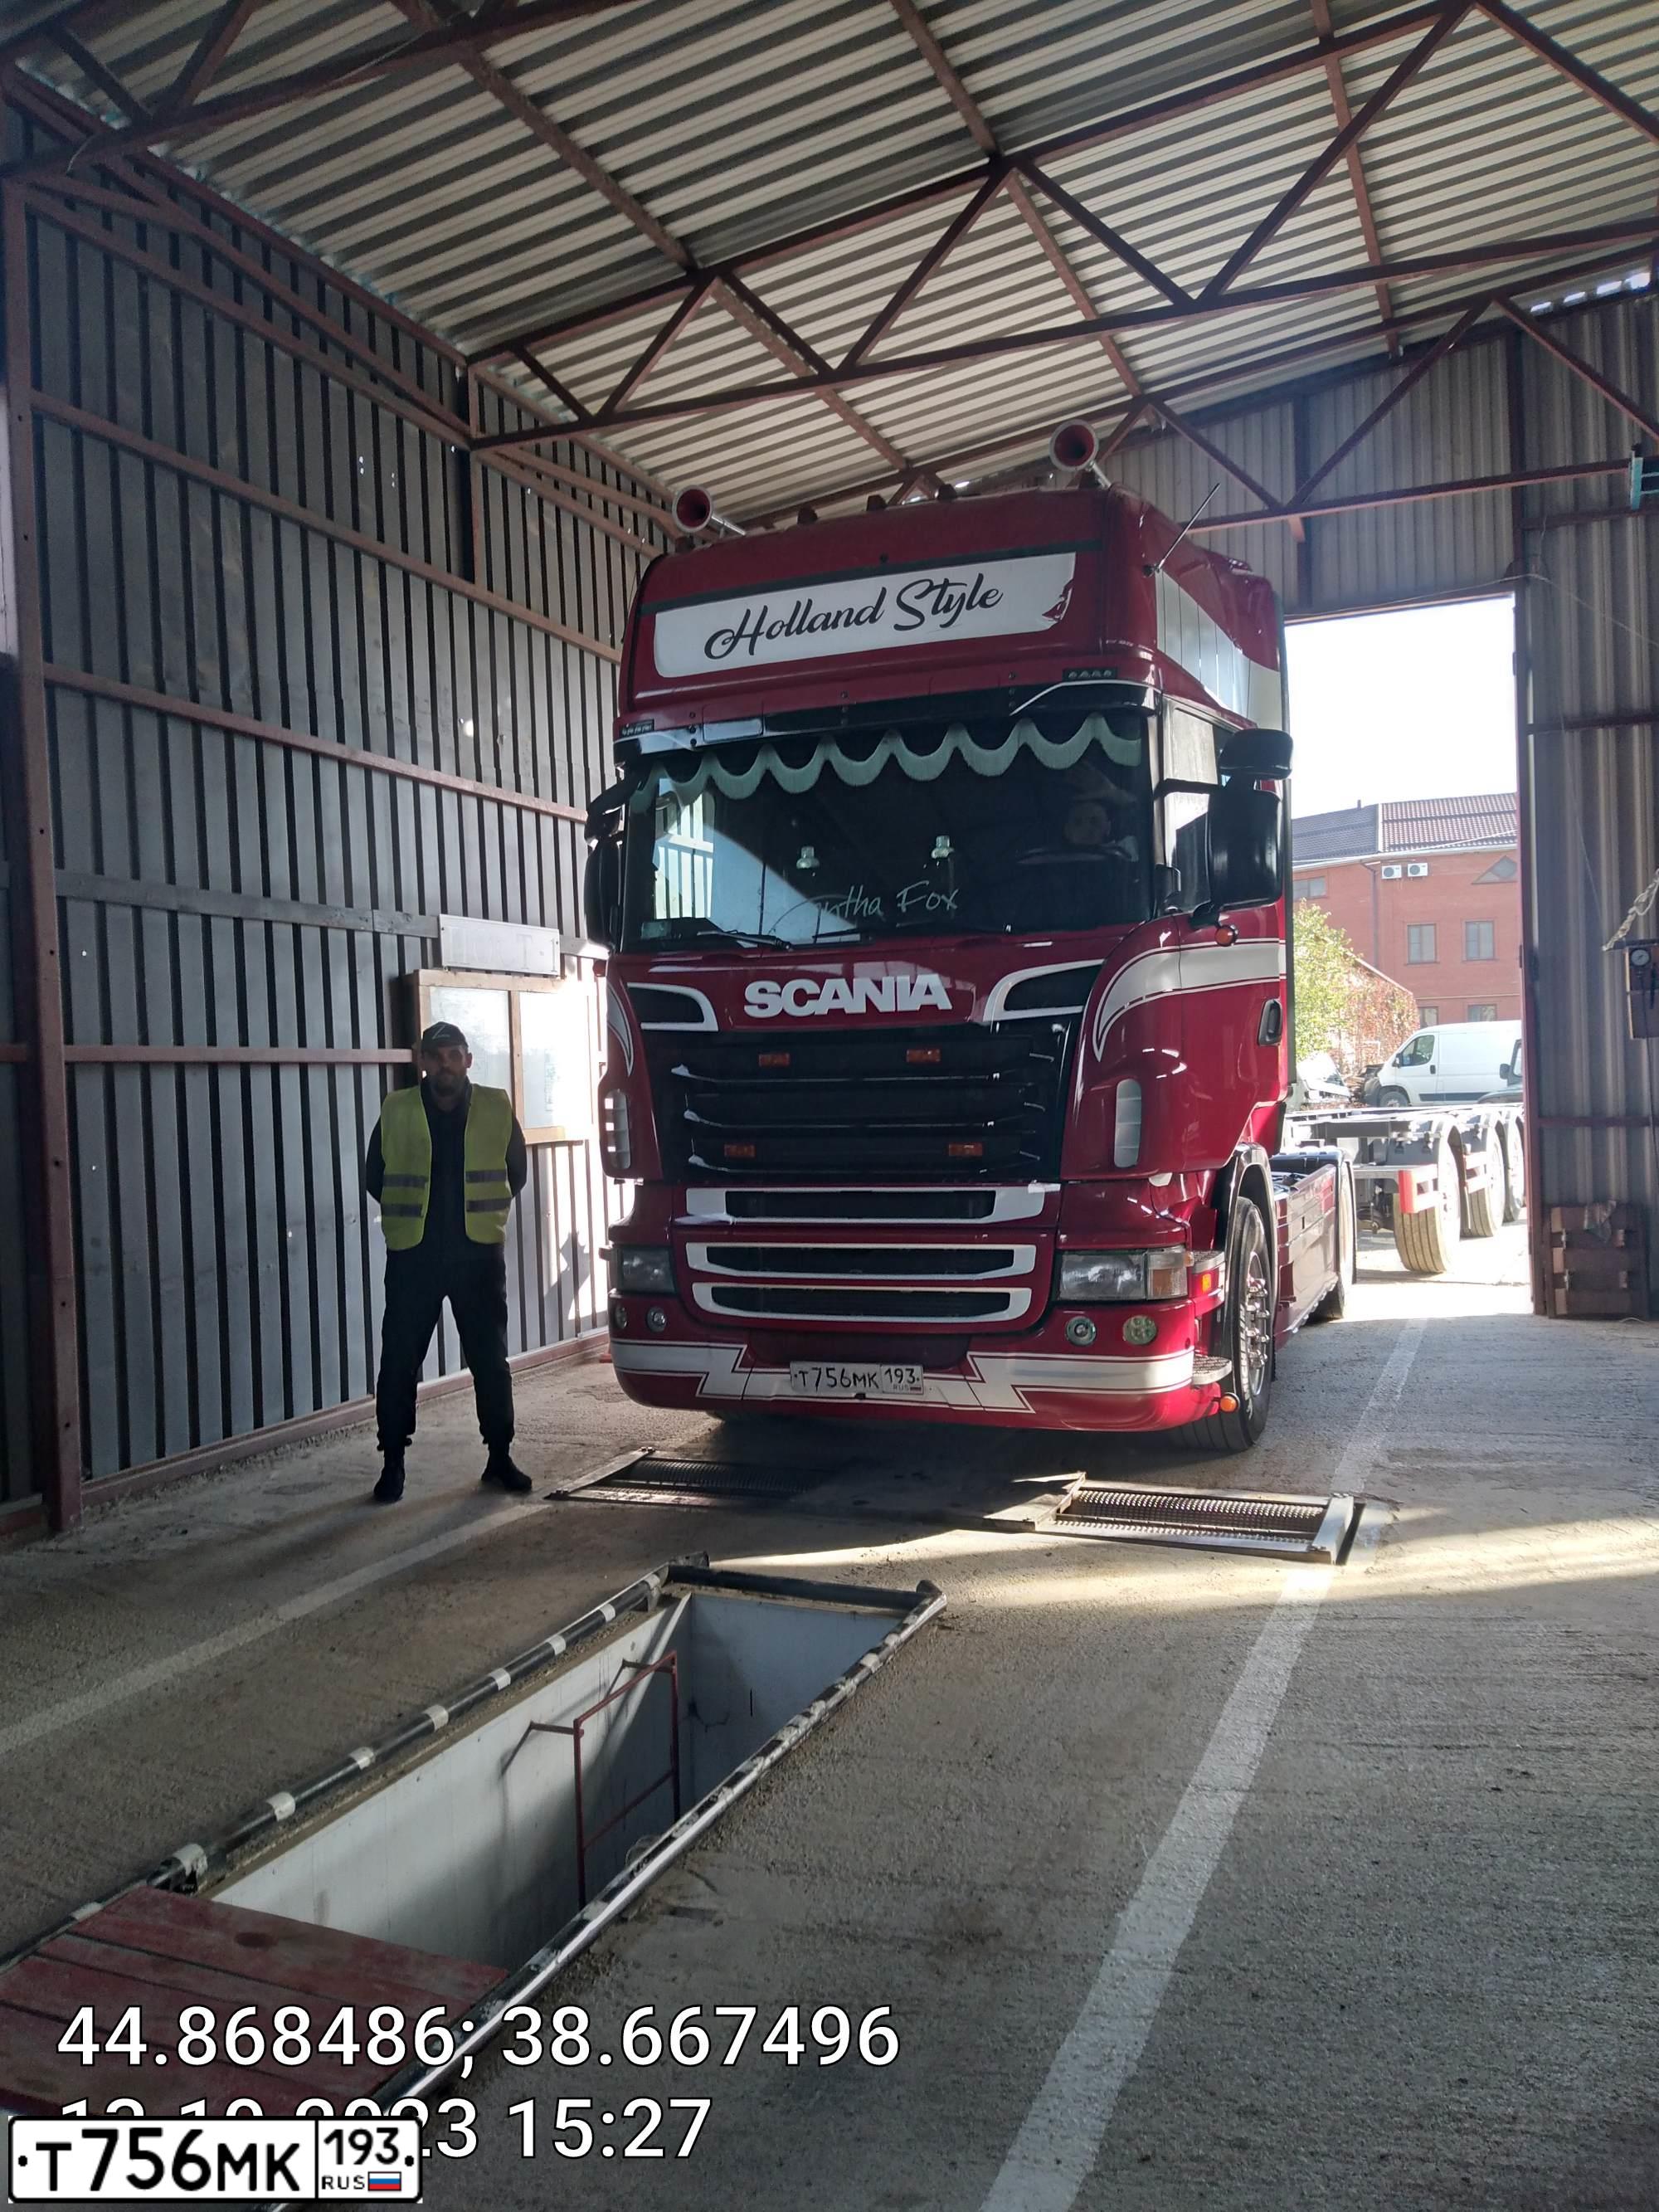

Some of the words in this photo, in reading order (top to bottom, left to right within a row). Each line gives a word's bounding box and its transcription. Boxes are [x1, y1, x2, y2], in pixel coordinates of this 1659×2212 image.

[704, 587, 887, 660] Holland
[893, 572, 1004, 631] Style
[896, 879, 959, 913] Fox
[744, 973, 953, 1018] SCANIA
[884, 1368, 916, 1384] 193
